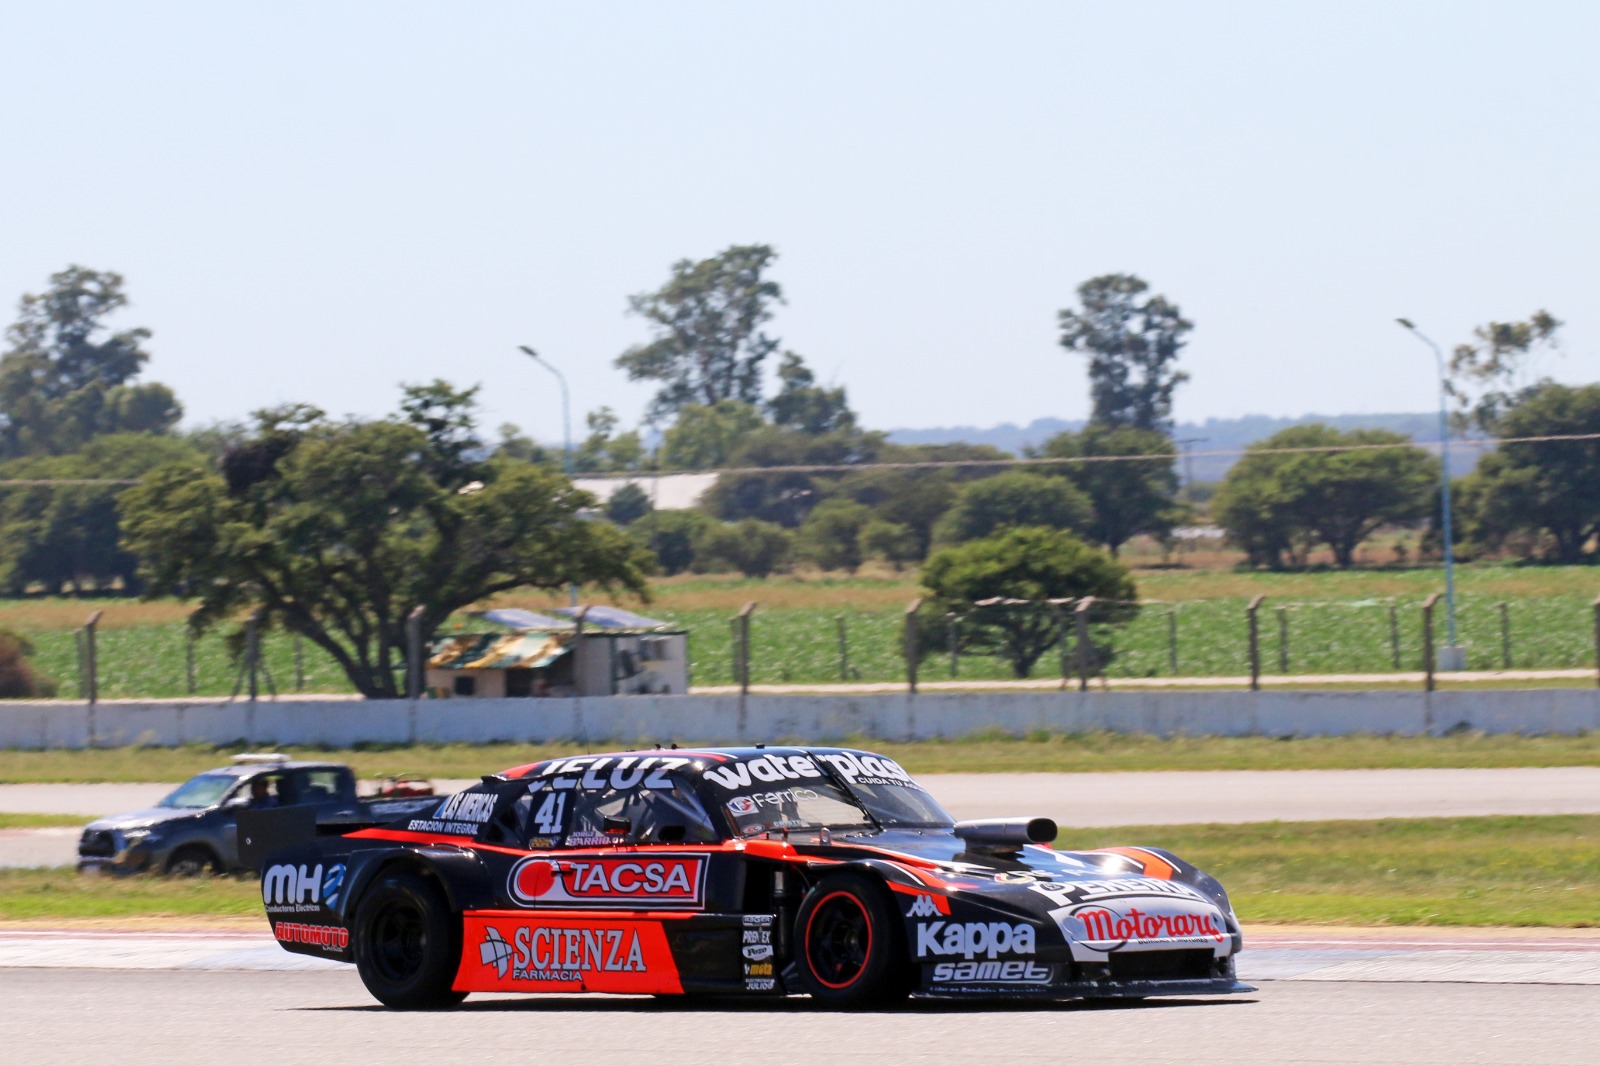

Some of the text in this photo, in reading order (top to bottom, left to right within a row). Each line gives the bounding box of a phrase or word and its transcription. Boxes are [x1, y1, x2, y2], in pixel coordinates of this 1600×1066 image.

[528, 757, 689, 793] JELUZ
[407, 819, 479, 835] ESTACION INTEGRAL
[534, 791, 566, 834] 41
[263, 863, 323, 904] MH
[570, 863, 691, 892] TACSA
[275, 922, 349, 949] AUTOMOTO
[512, 927, 647, 972] SCIENZA
[917, 921, 1036, 960] Kappa
[512, 969, 583, 984] FARMACIA
[933, 961, 1049, 982] samet
